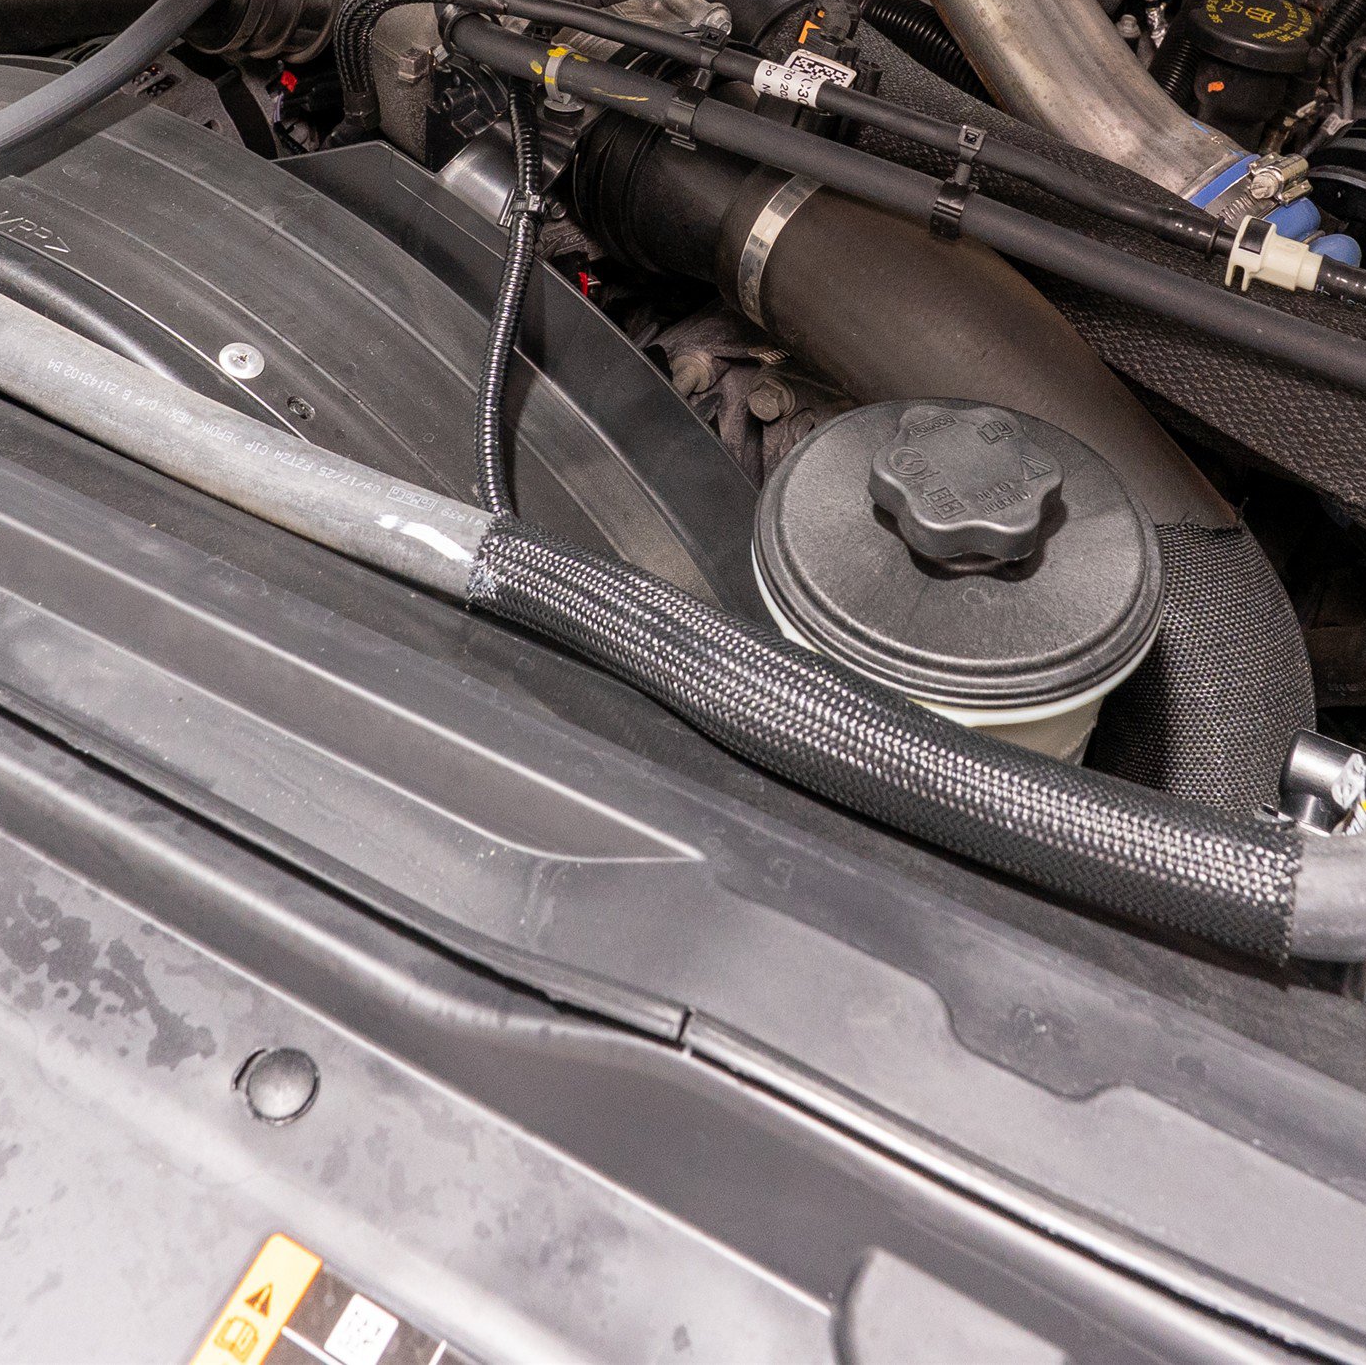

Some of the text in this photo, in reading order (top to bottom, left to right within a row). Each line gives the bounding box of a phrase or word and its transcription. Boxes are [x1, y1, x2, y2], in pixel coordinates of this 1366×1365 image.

[45, 357, 63, 372] B4
[62, 364, 120, 395] 21:43:02
[244, 437, 269, 455] CIP
[317, 463, 381, 497] 09/17/25
